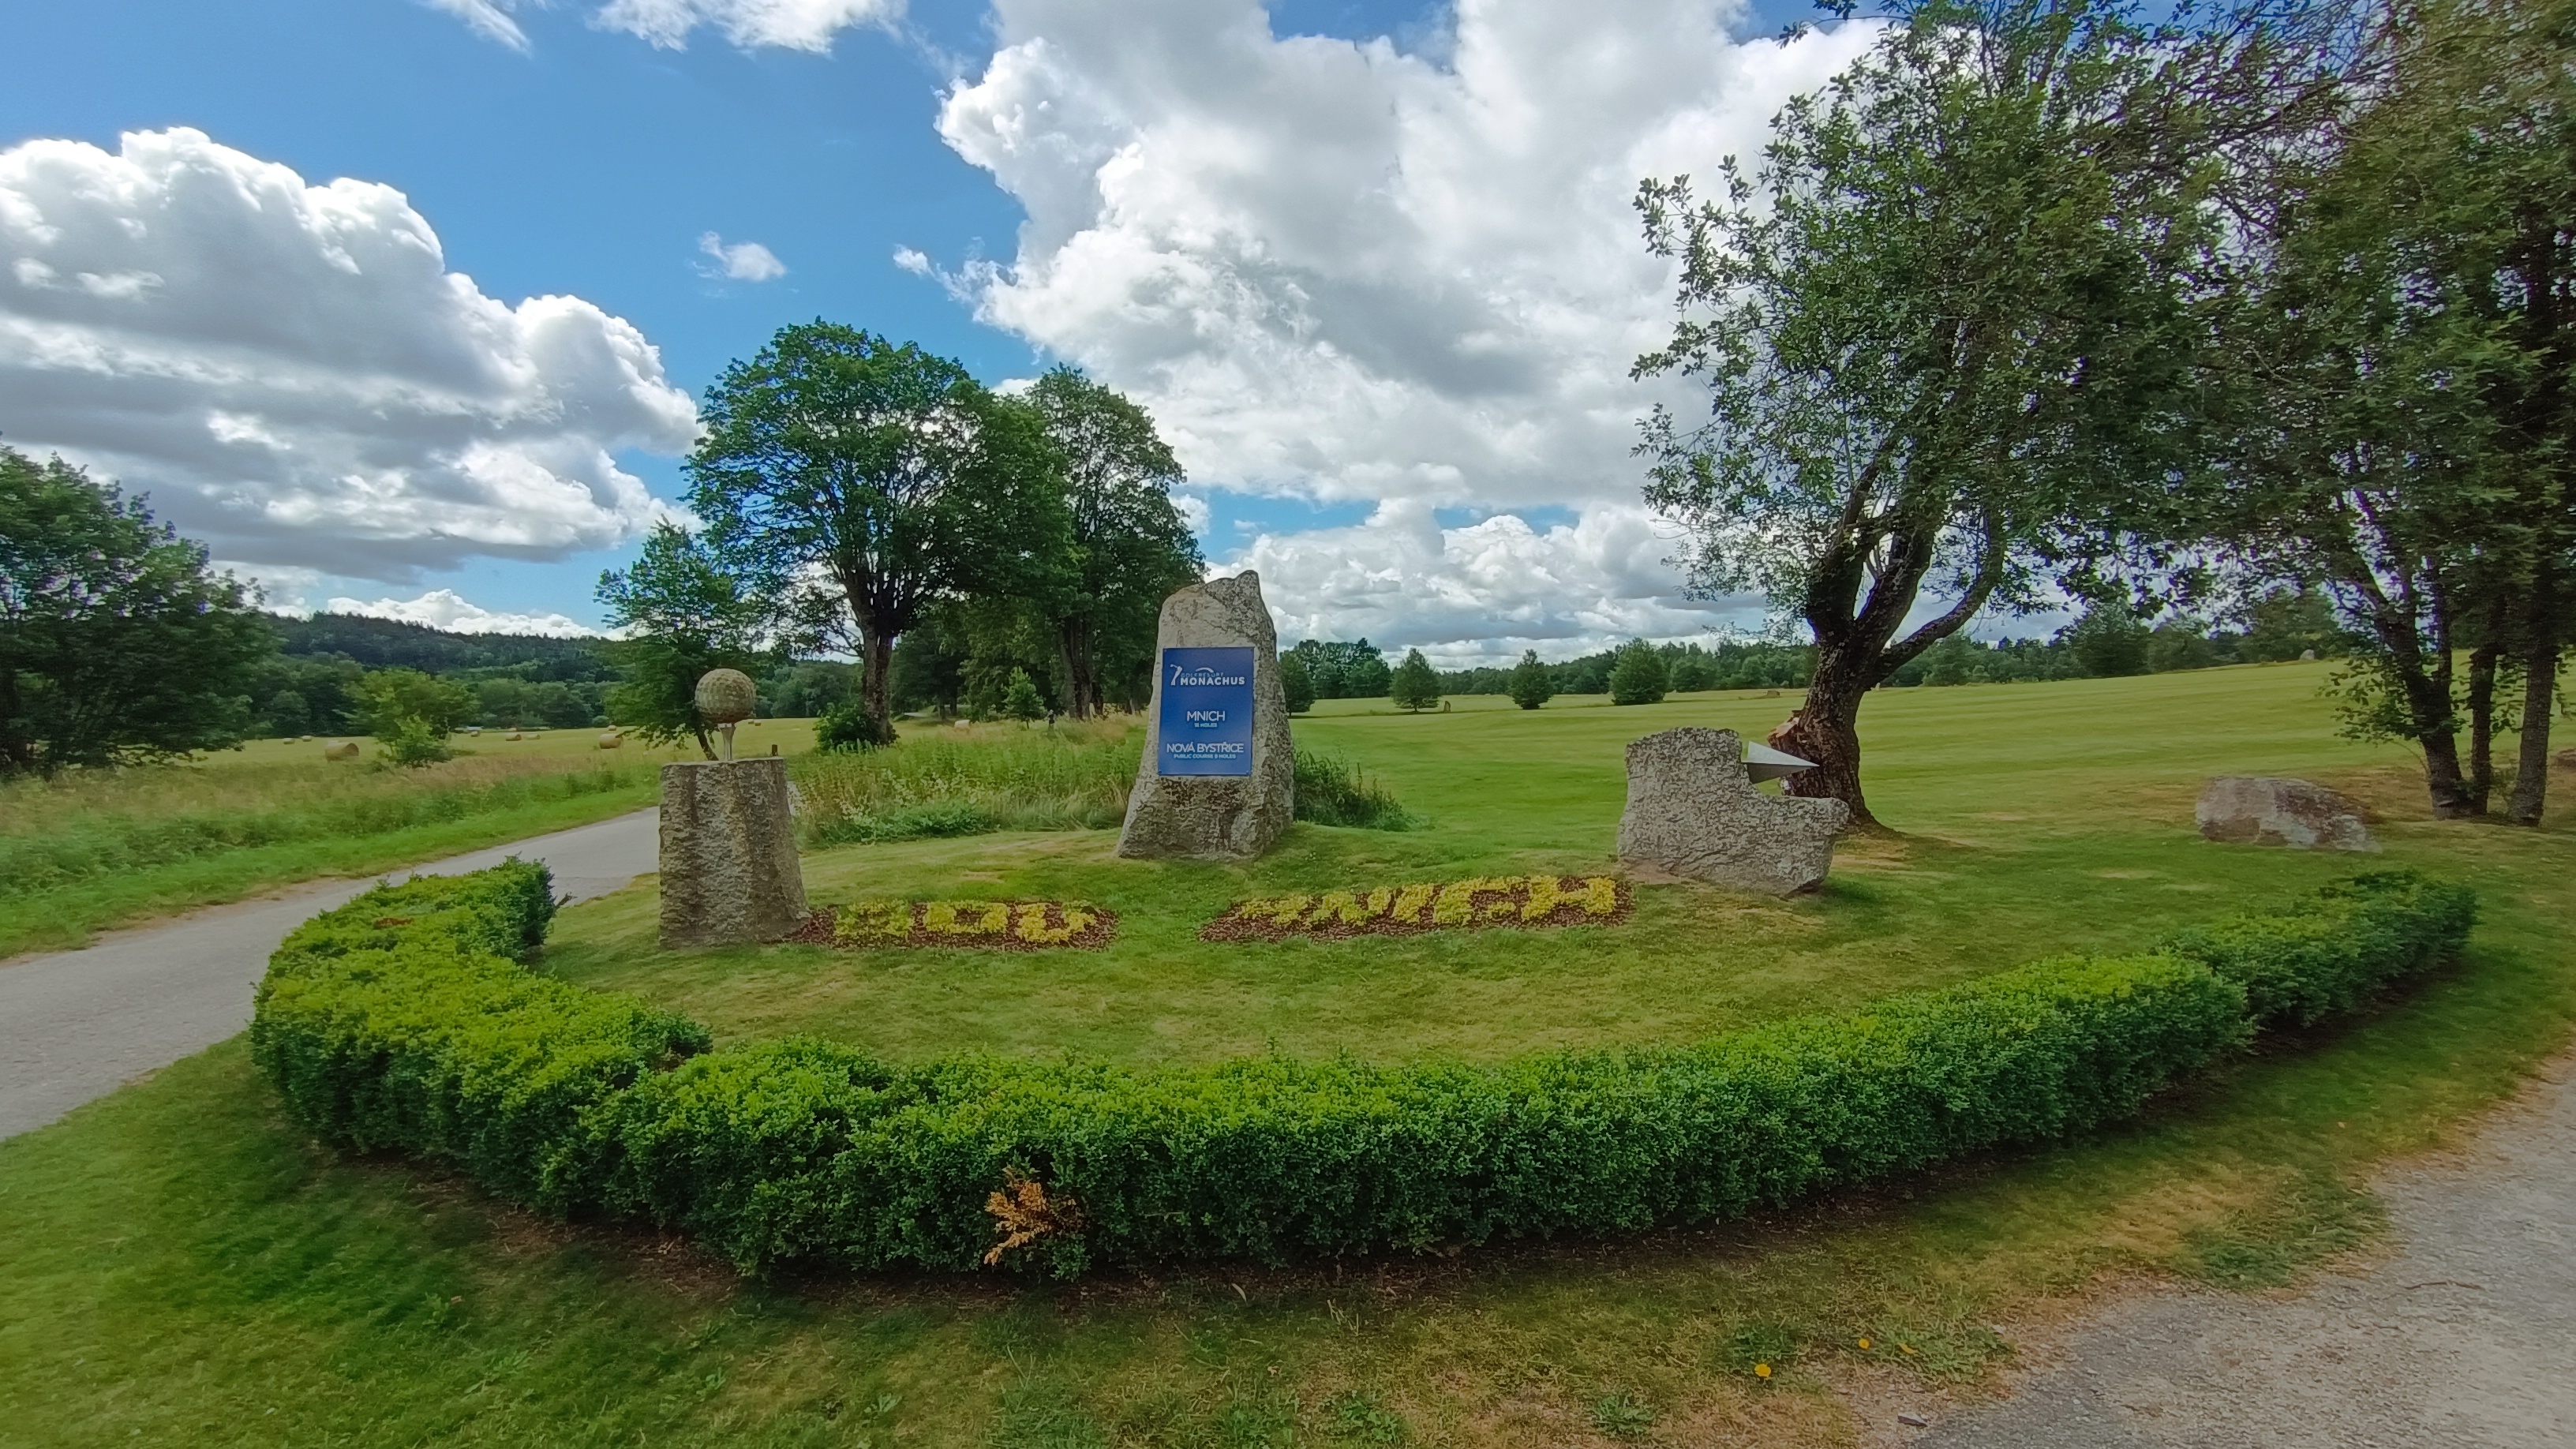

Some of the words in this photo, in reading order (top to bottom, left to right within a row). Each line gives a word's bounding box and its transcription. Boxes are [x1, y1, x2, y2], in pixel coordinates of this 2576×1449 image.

[1186, 710, 1226, 721] MNICH
[1166, 741, 1196, 753] NOVÁ
[1196, 741, 1245, 753] BYSTŘICE
